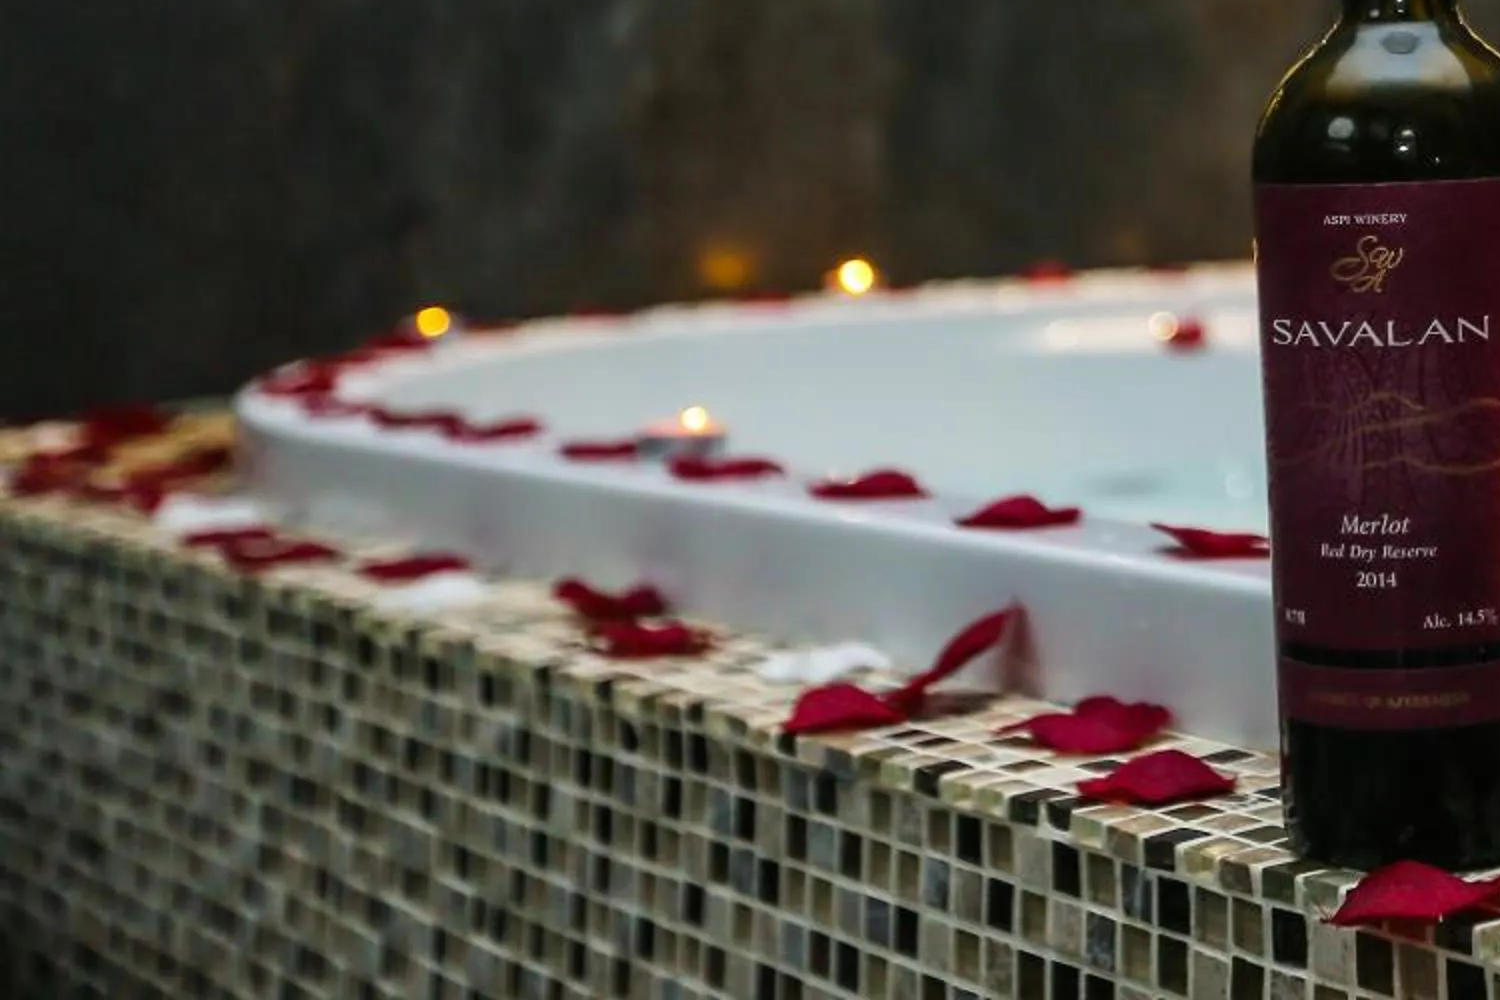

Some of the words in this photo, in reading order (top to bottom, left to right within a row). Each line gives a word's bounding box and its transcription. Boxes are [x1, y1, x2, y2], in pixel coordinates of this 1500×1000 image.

[1323, 215, 1351, 226] ASPI
[1354, 213, 1407, 225] WINERY
[1272, 315, 1490, 347] SAVALAN
[1340, 513, 1411, 535] Merlot
[1321, 543, 1345, 557] Red
[1350, 544, 1377, 562] Dry
[1382, 544, 1438, 559] Reserve
[1356, 571, 1398, 588] 2014
[1423, 614, 1451, 629] Alc.
[1457, 608, 1499, 627] 14.5%
